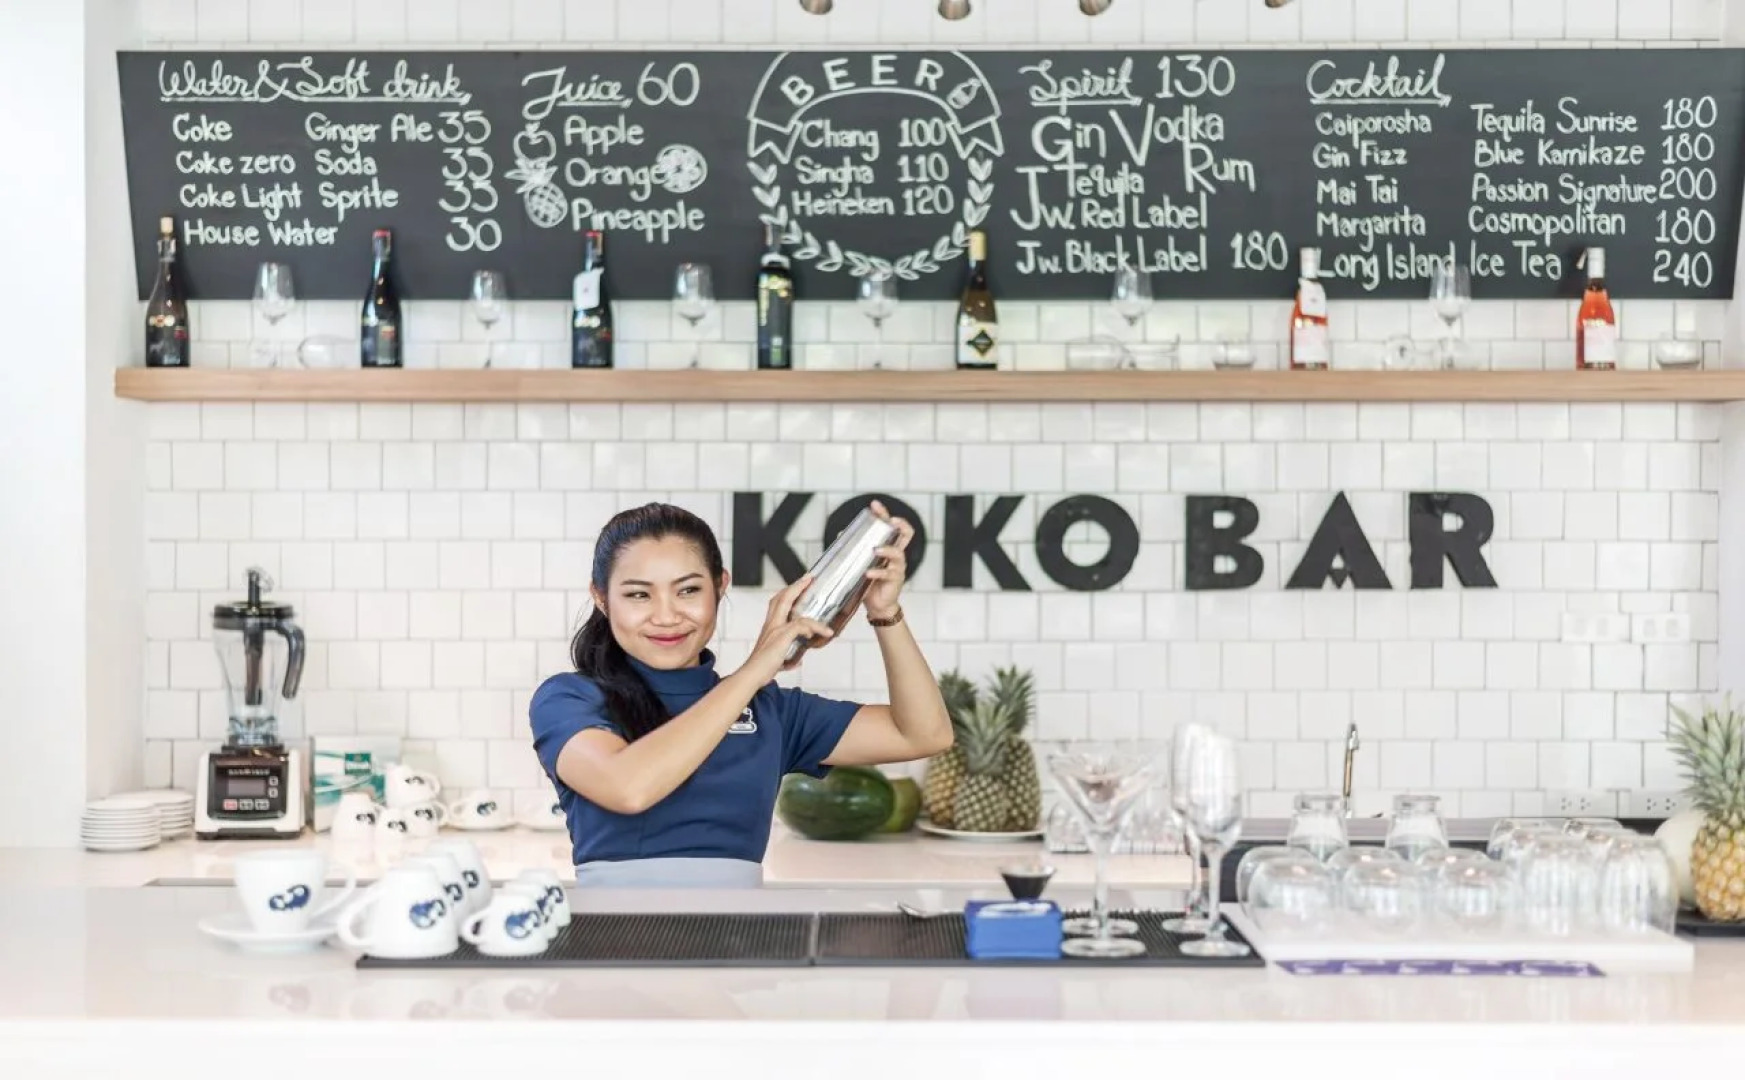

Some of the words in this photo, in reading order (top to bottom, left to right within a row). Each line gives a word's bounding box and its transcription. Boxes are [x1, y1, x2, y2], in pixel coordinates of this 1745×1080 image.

[158, 60, 252, 97] Water
[277, 56, 371, 98] Soft
[521, 65, 625, 120] Juice
[636, 61, 700, 106] 60
[780, 54, 944, 105] BEER
[1019, 58, 1132, 116] Spirit
[1155, 54, 1236, 98] 130
[1306, 53, 1448, 99] Cocktail
[172, 113, 232, 142] Coke
[305, 112, 380, 153] Ginger
[390, 113, 433, 143] Ale
[437, 110, 491, 144] 35
[564, 114, 644, 156] Apple
[801, 119, 880, 161] Chang
[898, 117, 946, 147] 100
[1031, 115, 1107, 162] Gin
[1109, 103, 1224, 167] Vodka
[1470, 100, 1545, 142] Tequila
[1556, 96, 1638, 134] Sunrise
[1660, 95, 1717, 130] 180
[175, 151, 233, 174] Coke
[239, 154, 296, 174] zero
[314, 148, 377, 175] Soda
[441, 147, 493, 180] 35
[1184, 143, 1256, 194] Rum
[1313, 142, 1350, 168] Gin
[1361, 140, 1407, 166] Fizz
[1474, 139, 1524, 168] Blue
[1538, 135, 1646, 165] Kamikaze
[1662, 133, 1715, 164] 180
[565, 157, 667, 202] Orange
[794, 155, 874, 198] Singha
[897, 152, 949, 183] 110
[1317, 178, 1357, 205] Mai
[1364, 174, 1398, 203] Tai
[1472, 172, 1549, 202] Passion
[1559, 173, 1657, 212] Signature
[1659, 167, 1717, 201] 200
[179, 183, 236, 208] Coke
[241, 182, 302, 222] Light
[318, 177, 398, 222] Sprite
[438, 180, 498, 213] 35
[571, 197, 705, 244] Pineapple
[791, 187, 894, 216] Heineken
[902, 184, 955, 216] 120
[1081, 190, 1125, 229] Red
[1133, 190, 1208, 229] Label
[184, 219, 259, 246] House
[267, 218, 338, 246] Water
[445, 217, 502, 251] 30
[1317, 204, 1426, 252] Margarita
[1468, 203, 1625, 247] Cosmopolitan
[1654, 207, 1716, 244] 180
[1066, 235, 1137, 277] Black
[1137, 233, 1207, 272] Label
[1230, 230, 1288, 271] 180
[1387, 240, 1455, 280] Island
[1470, 240, 1505, 277] Ice
[1512, 240, 1561, 280] Tea
[1653, 249, 1712, 288] 240
[1185, 490, 1498, 590] BAR
